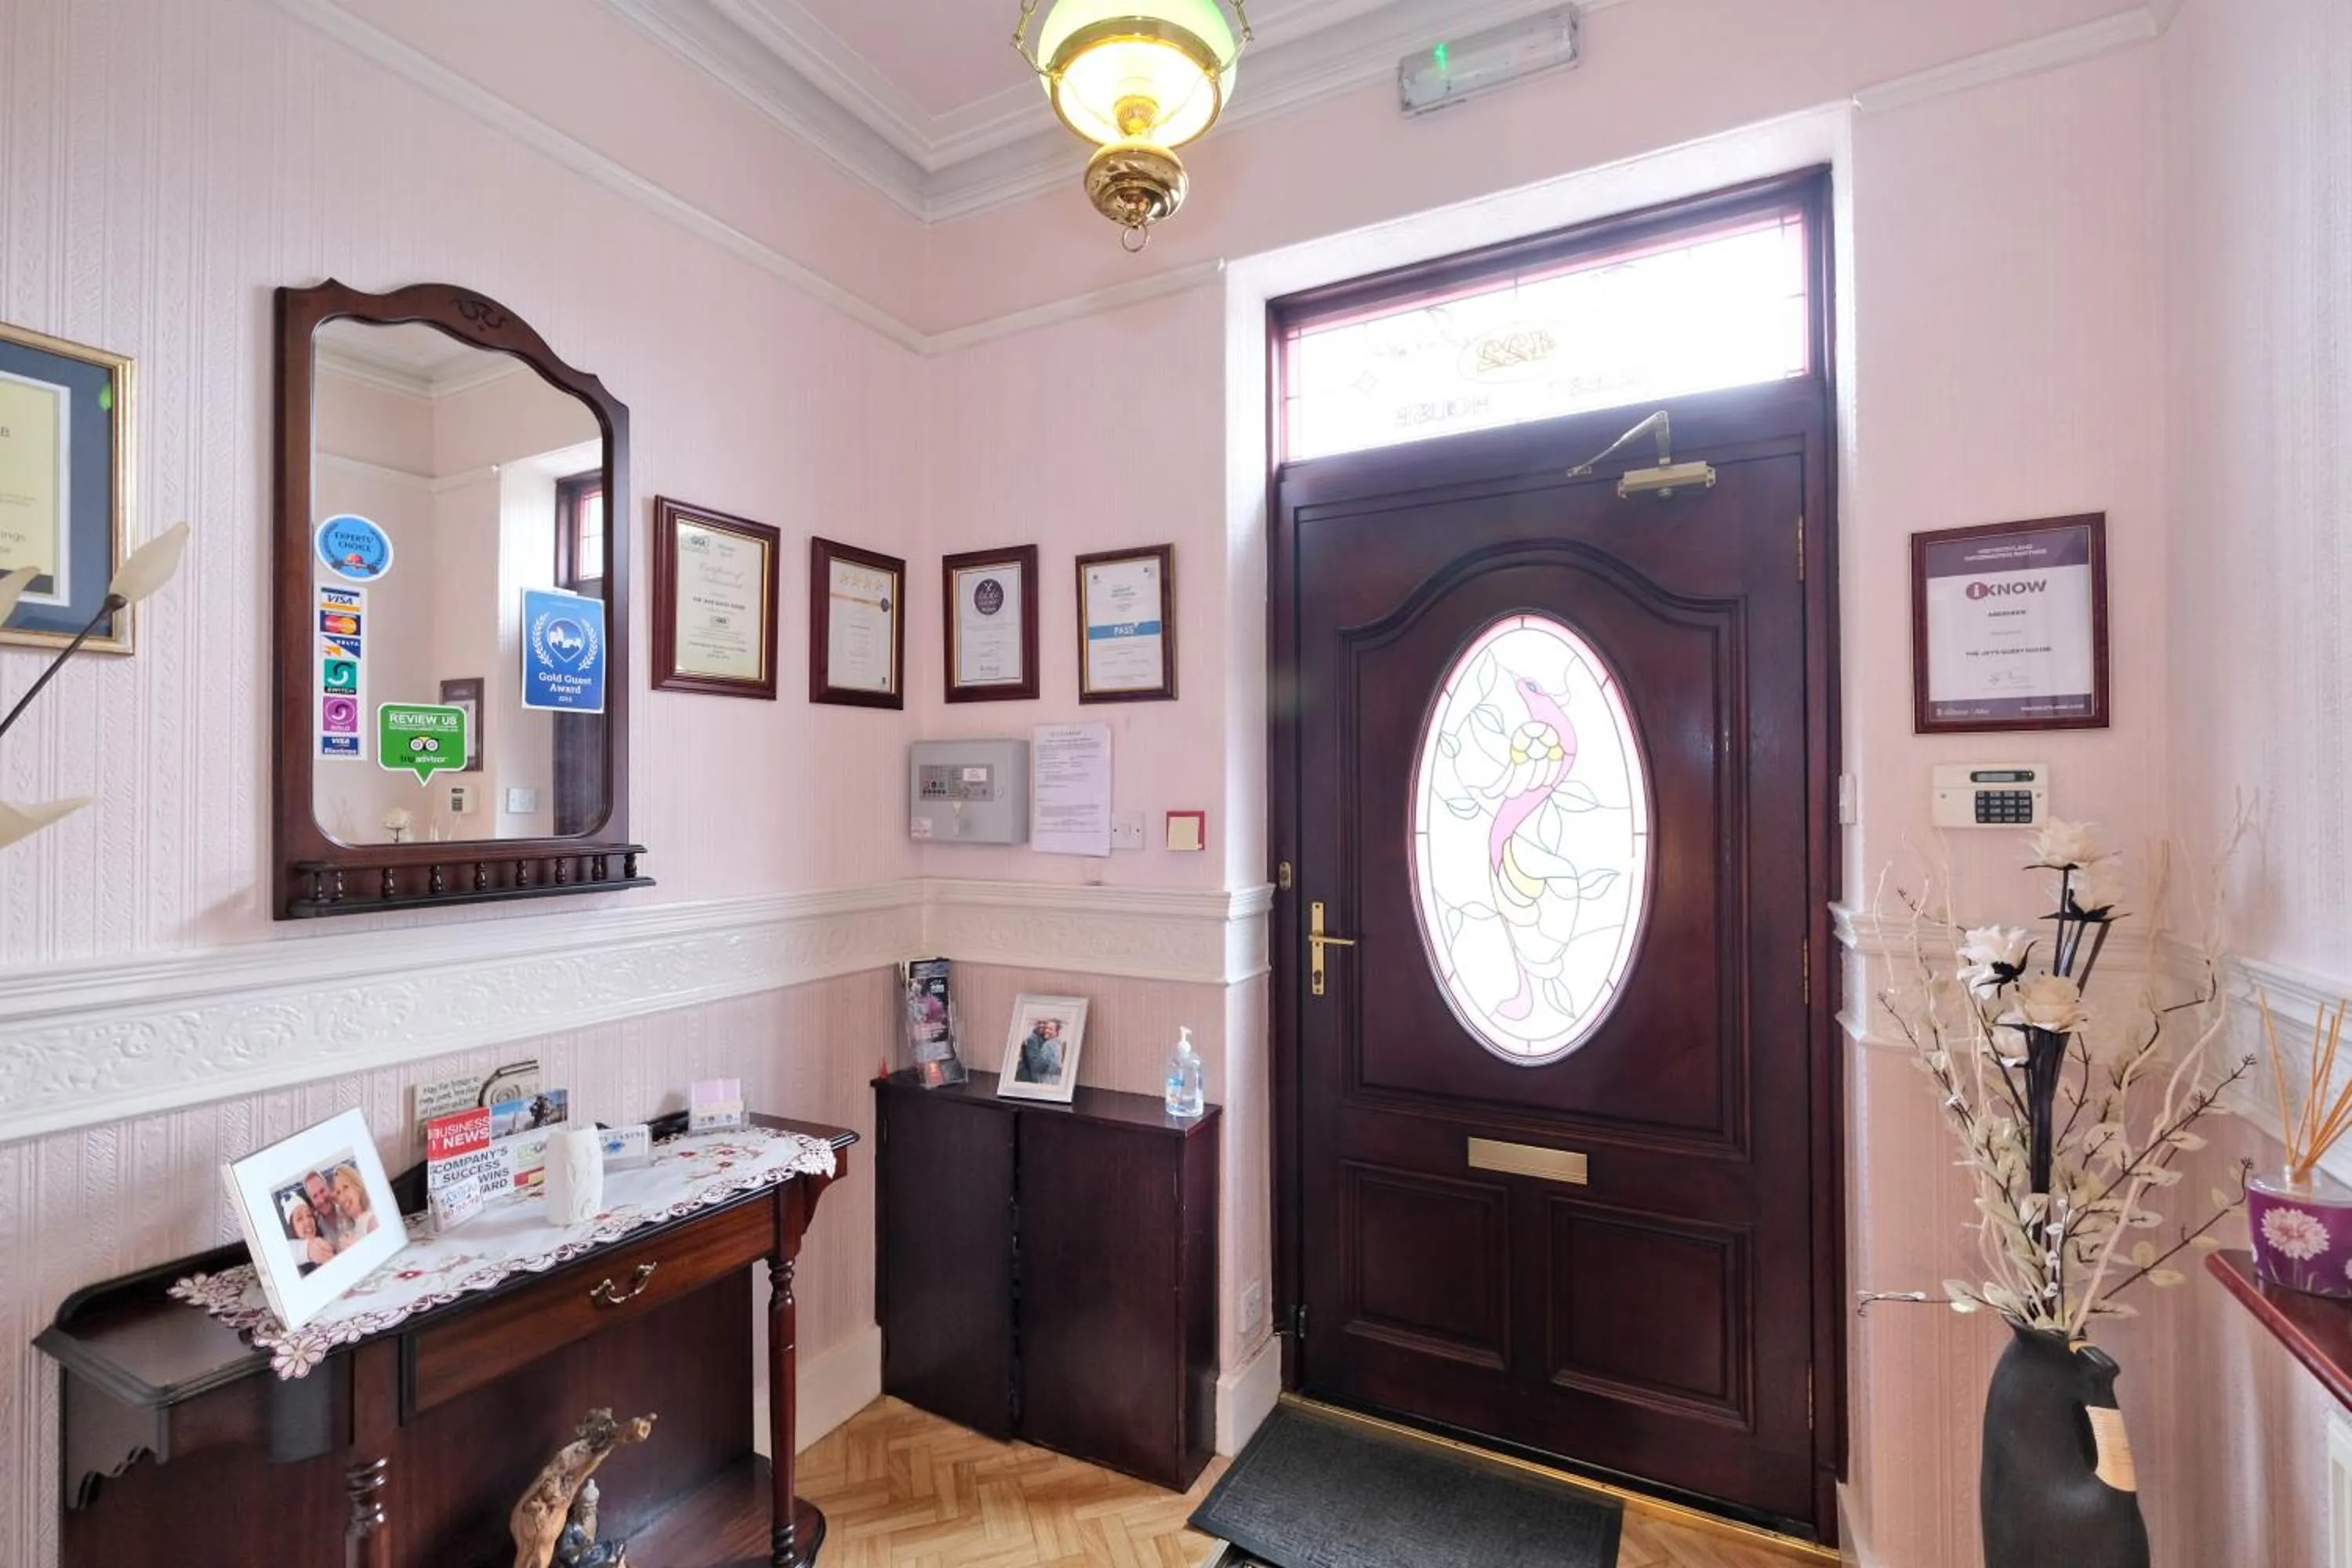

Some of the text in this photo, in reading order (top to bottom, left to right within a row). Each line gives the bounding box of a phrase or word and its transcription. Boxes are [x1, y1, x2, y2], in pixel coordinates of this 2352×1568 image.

[327, 593, 354, 605] VISA
[1114, 626, 1134, 636] PASS
[539, 672, 563, 683] Gold
[550, 683, 582, 694] Award
[390, 713, 458, 725] REVIEW US
[428, 1116, 490, 1139] BUSINESS
[443, 1127, 490, 1150] NEWS
[433, 1145, 509, 1174] COMPANY'S
[442, 1160, 501, 1183] SUCCESS
[477, 1167, 510, 1183] WINS
